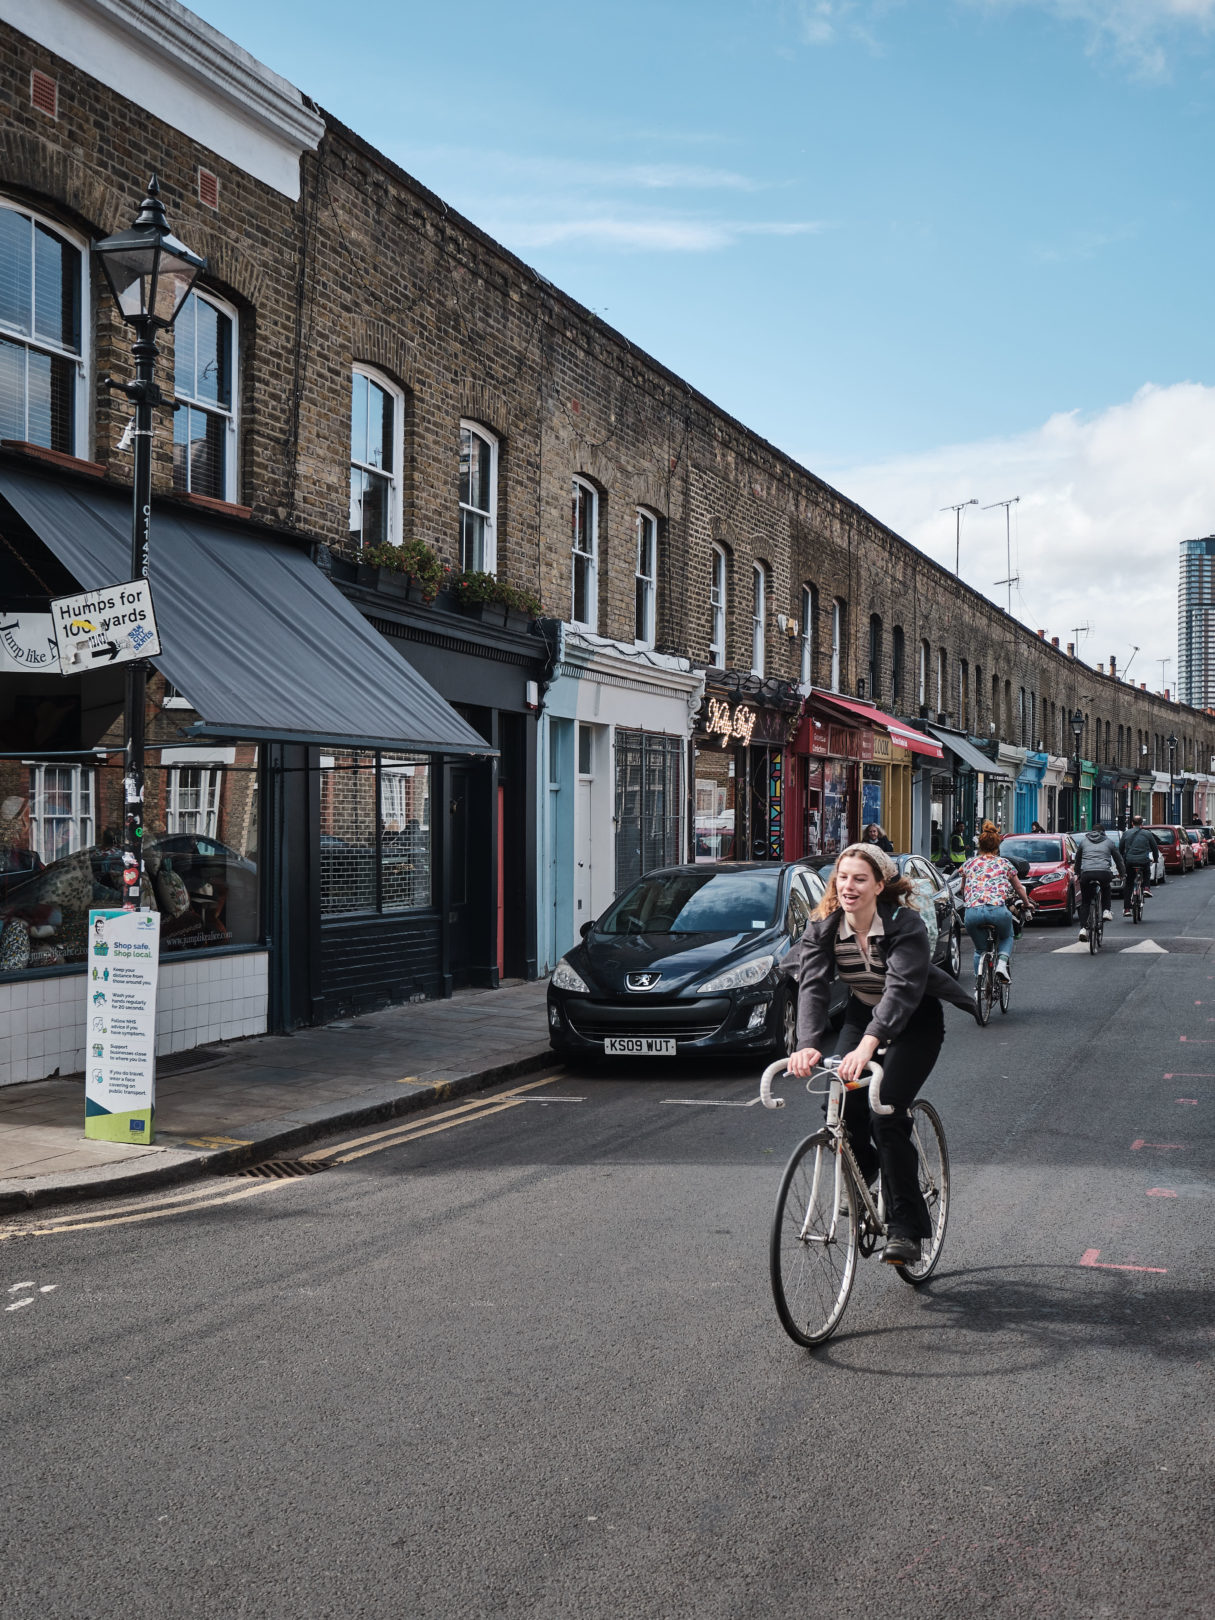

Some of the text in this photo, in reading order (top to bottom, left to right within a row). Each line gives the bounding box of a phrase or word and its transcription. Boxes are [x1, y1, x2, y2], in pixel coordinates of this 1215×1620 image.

[60, 591, 143, 620] Humps for
[102, 608, 147, 631] yards
[132, 629, 145, 643] CITY
[26, 644, 47, 664] like
[114, 942, 132, 950] Shop
[113, 950, 132, 958] Shop
[610, 1040, 670, 1052] KS09 WUT
